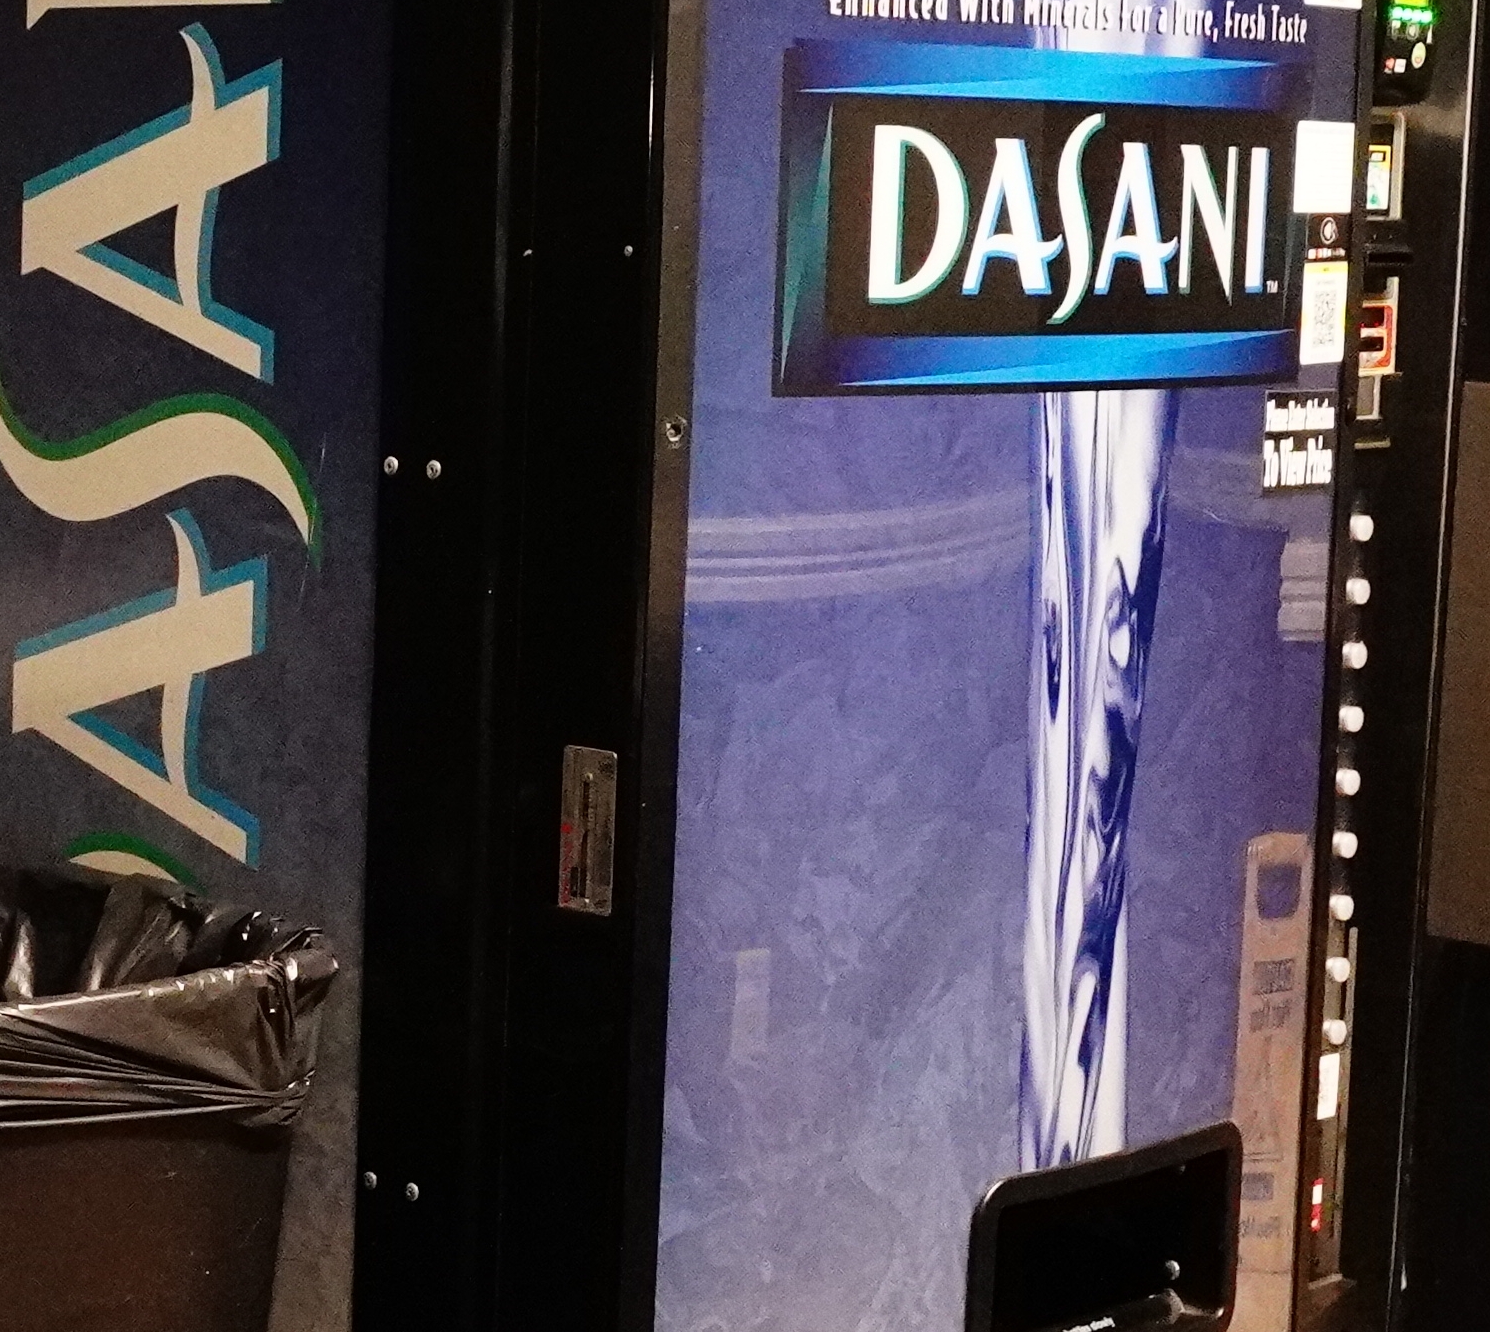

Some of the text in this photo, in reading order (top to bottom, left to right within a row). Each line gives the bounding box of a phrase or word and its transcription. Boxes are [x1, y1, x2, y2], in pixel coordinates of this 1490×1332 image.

[1172, 2, 1220, 44] Pure,
[1224, 0, 1266, 41] Fresh
[1269, 3, 1309, 45] Taste
[868, 113, 1270, 325] DASANI
[1263, 434, 1333, 488] To View Price
